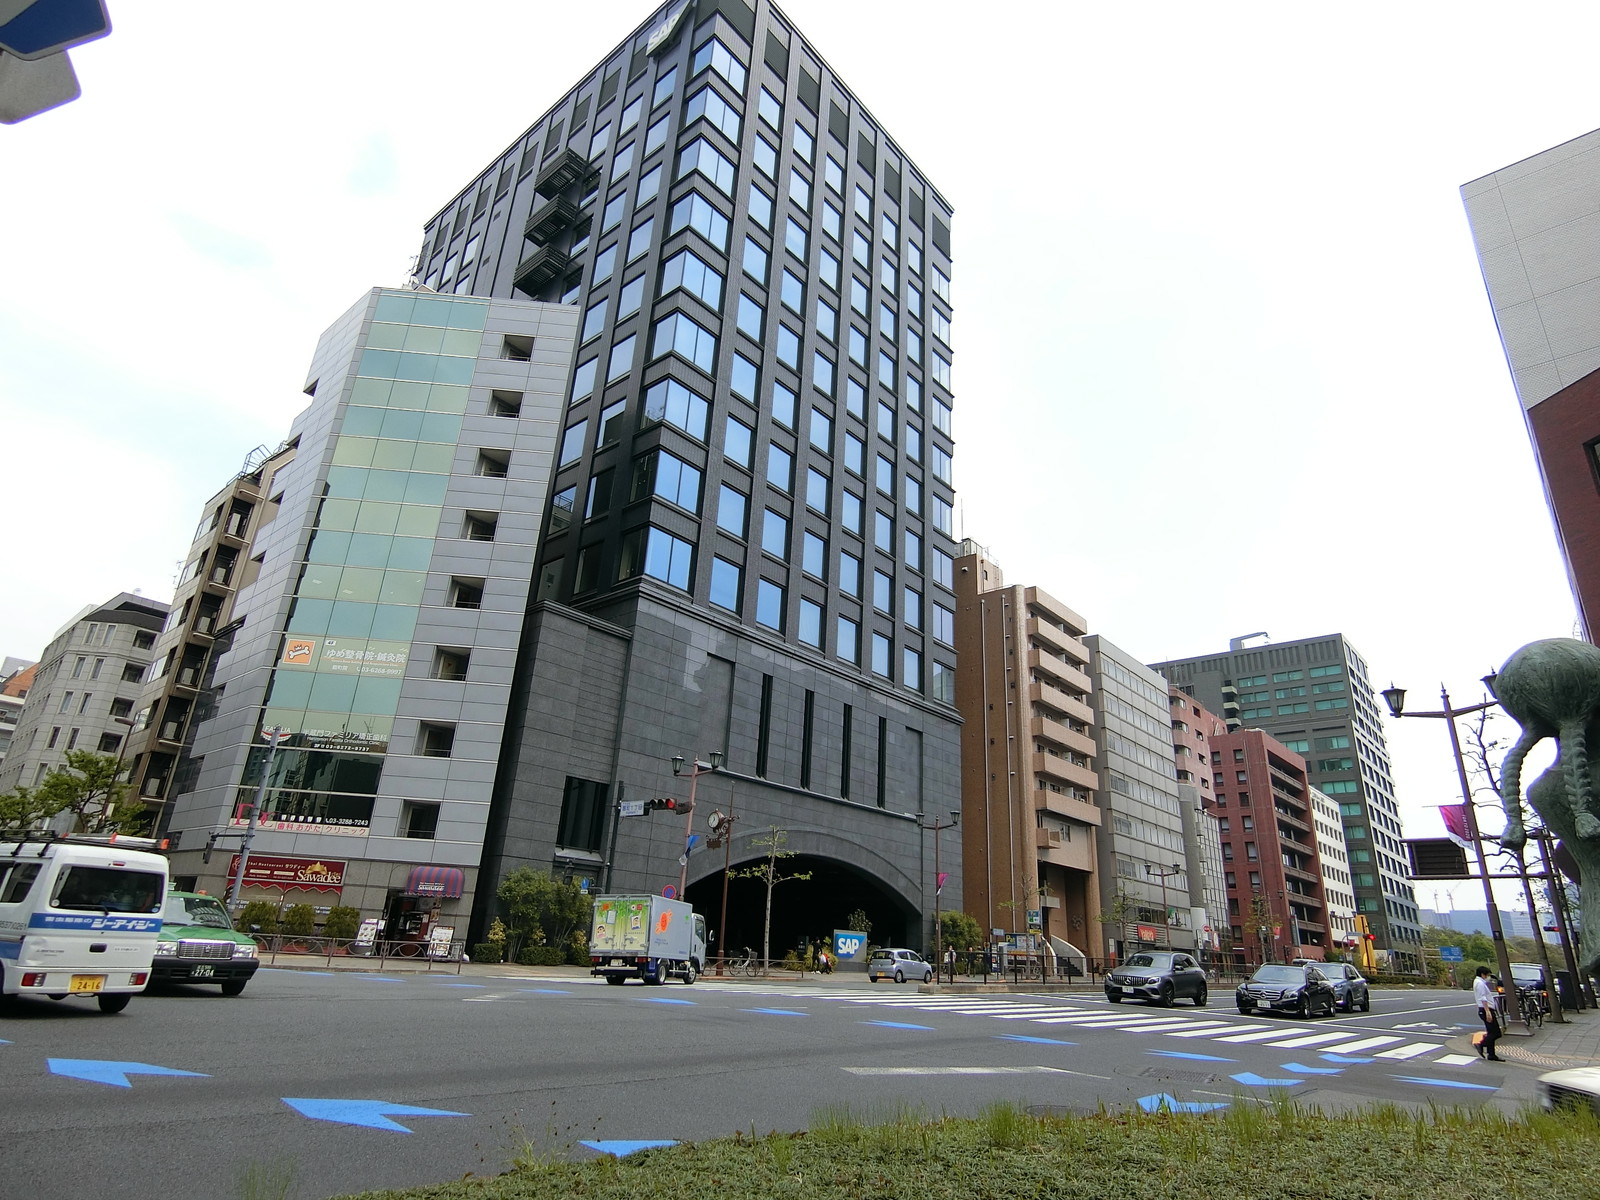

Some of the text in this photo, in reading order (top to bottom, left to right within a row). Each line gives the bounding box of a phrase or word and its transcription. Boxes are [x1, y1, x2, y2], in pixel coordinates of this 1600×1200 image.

[648, 13, 680, 48] SAP
[264, 725, 291, 734] FALIA
[296, 868, 342, 883] Sawadee
[838, 937, 860, 955] SAP
[77, 981, 101, 990] 24-16
